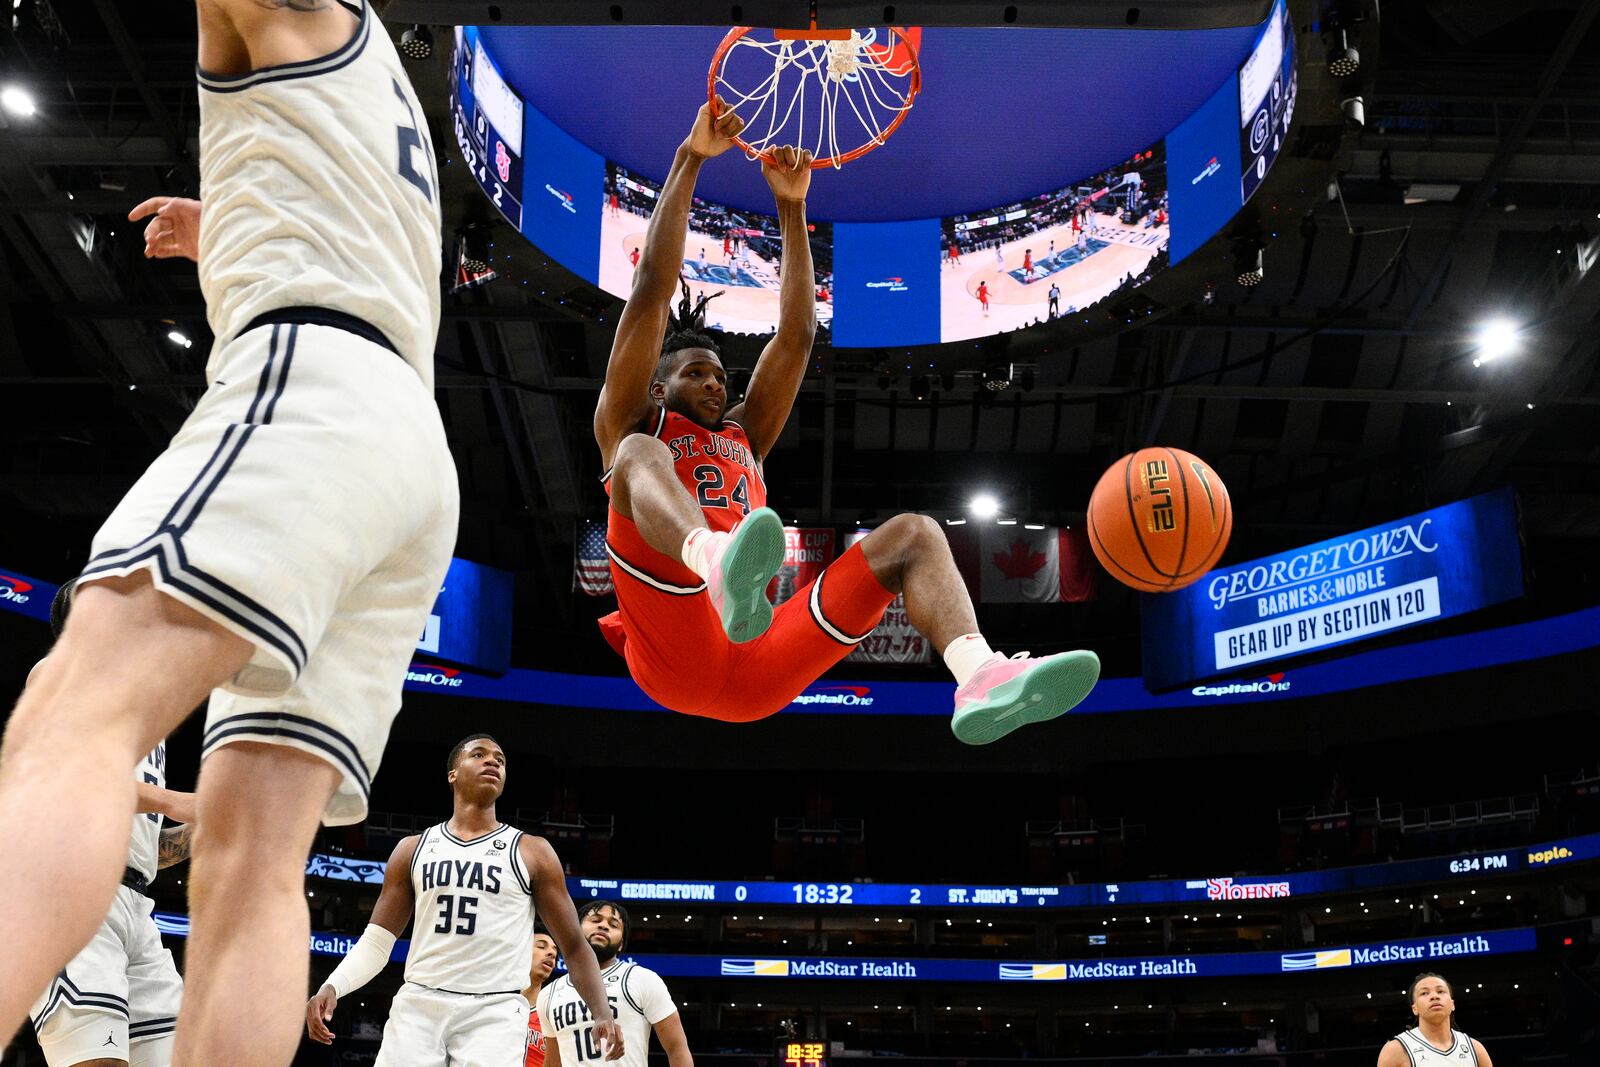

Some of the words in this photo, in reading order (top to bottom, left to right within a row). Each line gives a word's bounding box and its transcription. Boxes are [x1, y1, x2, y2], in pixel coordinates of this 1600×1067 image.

[693, 464, 751, 517] 24
[1146, 460, 1176, 532] ELITE
[805, 533, 829, 547] CUP
[1208, 518, 1438, 610] GEORGETOWN
[1228, 628, 1268, 660] GEAR
[1273, 623, 1293, 649] UP
[1299, 616, 1317, 643] BY
[1323, 598, 1391, 636] SECTION
[1396, 588, 1425, 618] 120
[1450, 858, 1480, 873] 6:34
[1483, 855, 1507, 870] PM
[422, 859, 502, 895] HOYAS
[591, 888, 598, 897] 0
[621, 883, 715, 900] GEORGETOWN
[735, 886, 747, 901] 0
[792, 884, 853, 904] 18:32
[910, 889, 921, 904] 2
[948, 889, 969, 903] ST.
[972, 888, 1018, 904] JOHN'S
[1038, 897, 1045, 905] 0
[1109, 894, 1116, 903] 4
[434, 894, 479, 936] 35
[1354, 945, 1425, 964] MedStar
[1429, 936, 1490, 956] Health
[791, 961, 858, 976] MedStar
[861, 961, 917, 977] Health
[1069, 962, 1137, 979] MedStar
[1140, 959, 1197, 976] Health
[553, 996, 618, 1032] HOYS
[573, 1026, 602, 1062] 10
[787, 1044, 823, 1059] 18:32
